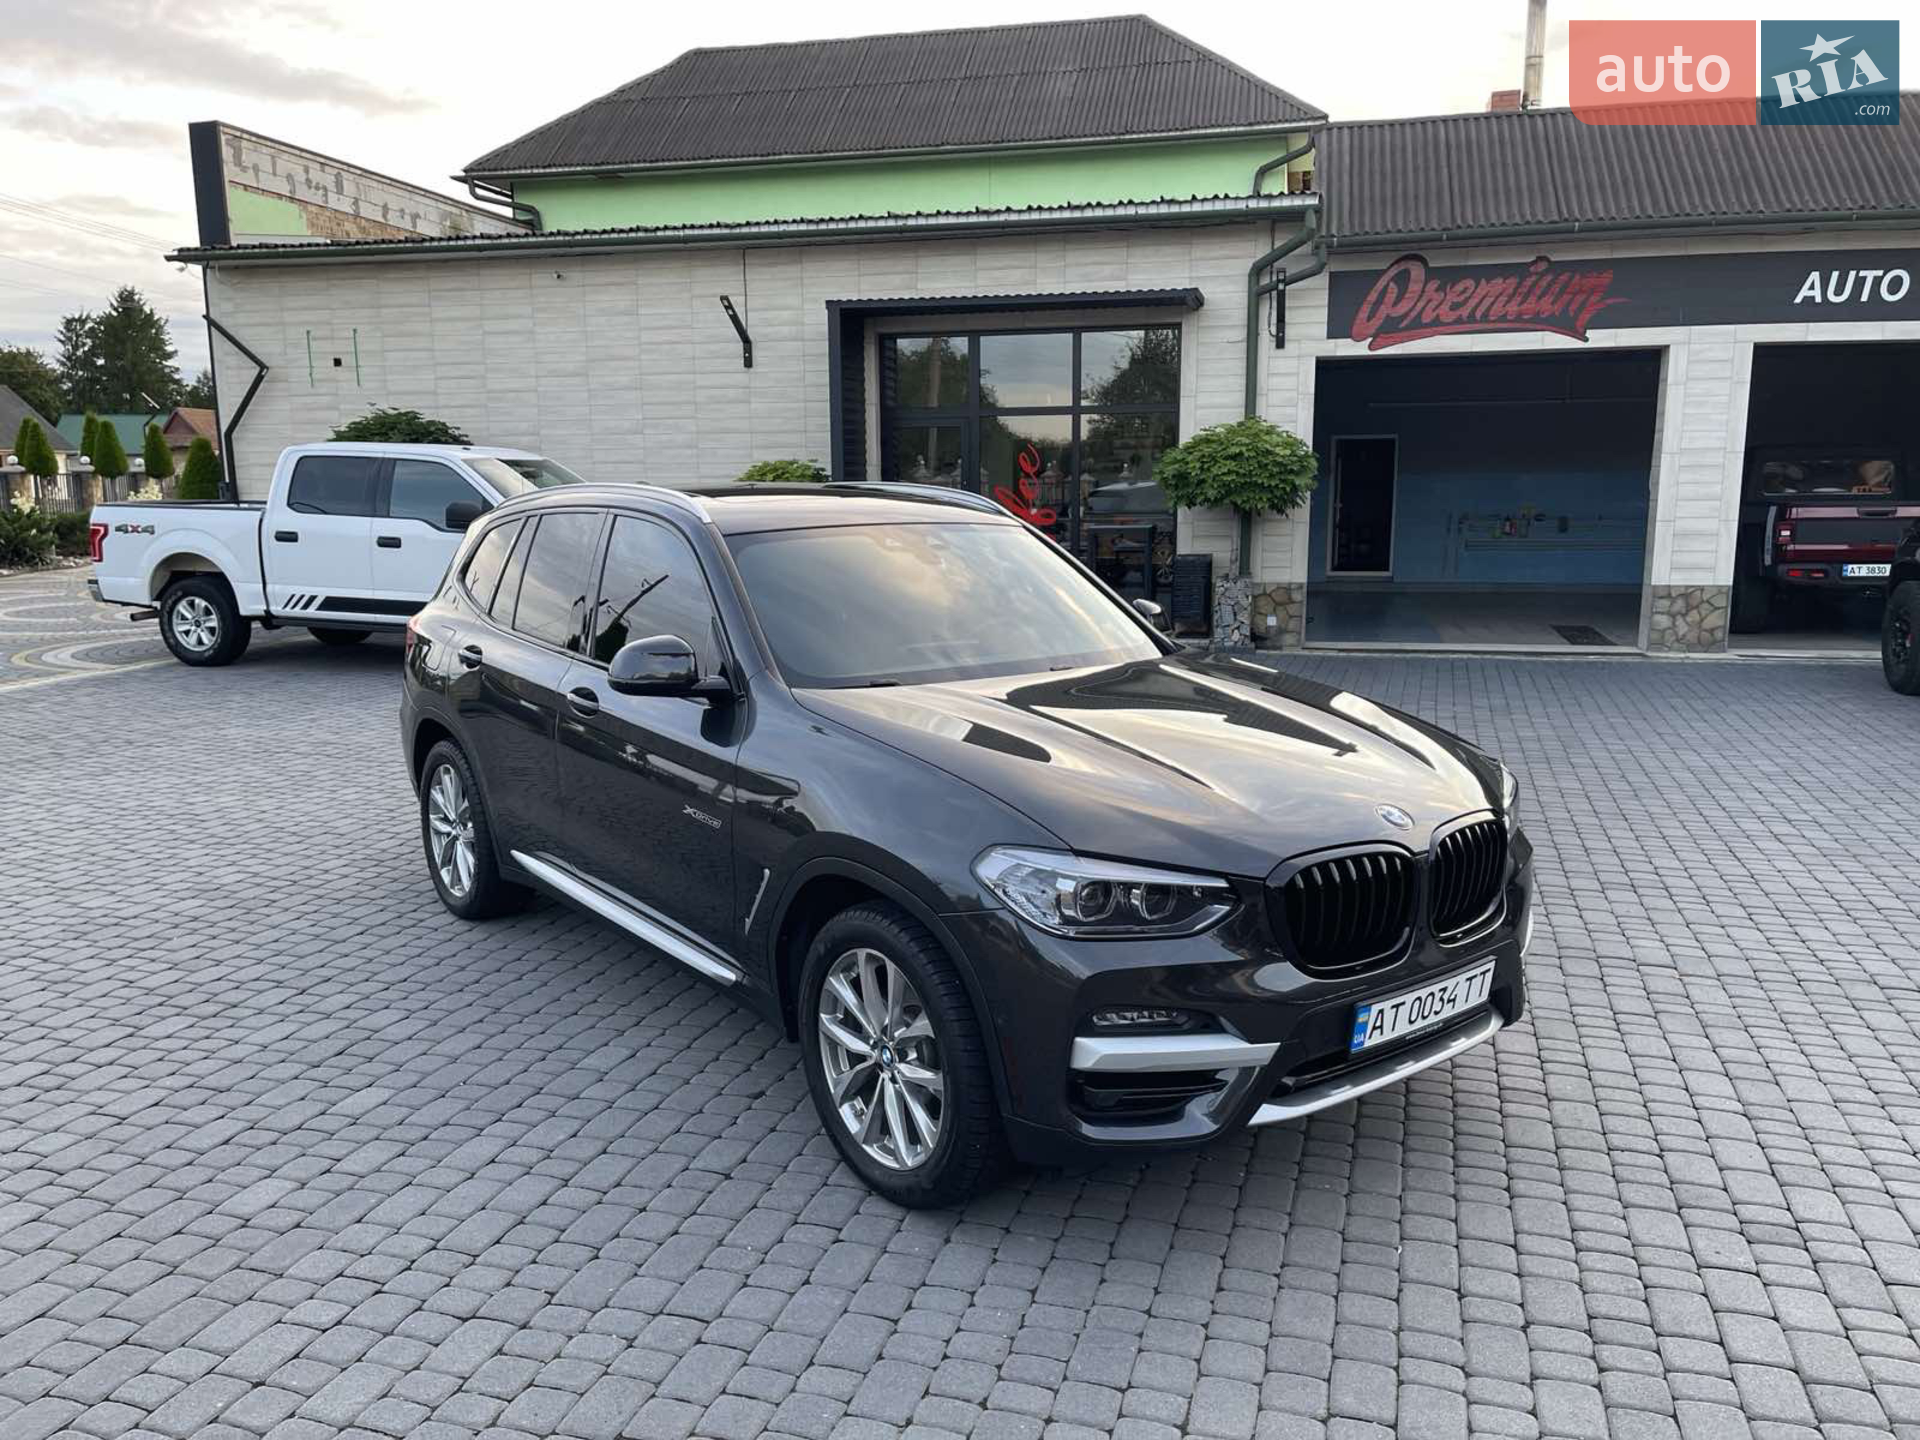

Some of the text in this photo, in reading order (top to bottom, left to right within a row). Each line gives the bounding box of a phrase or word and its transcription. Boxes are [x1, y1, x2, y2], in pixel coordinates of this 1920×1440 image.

[1351, 254, 1628, 349] Premium
[1793, 269, 1911, 304] AUTO
[1369, 1001, 1406, 1040] AT
[1408, 981, 1459, 1025] 0034
[1464, 968, 1492, 1003] TT
